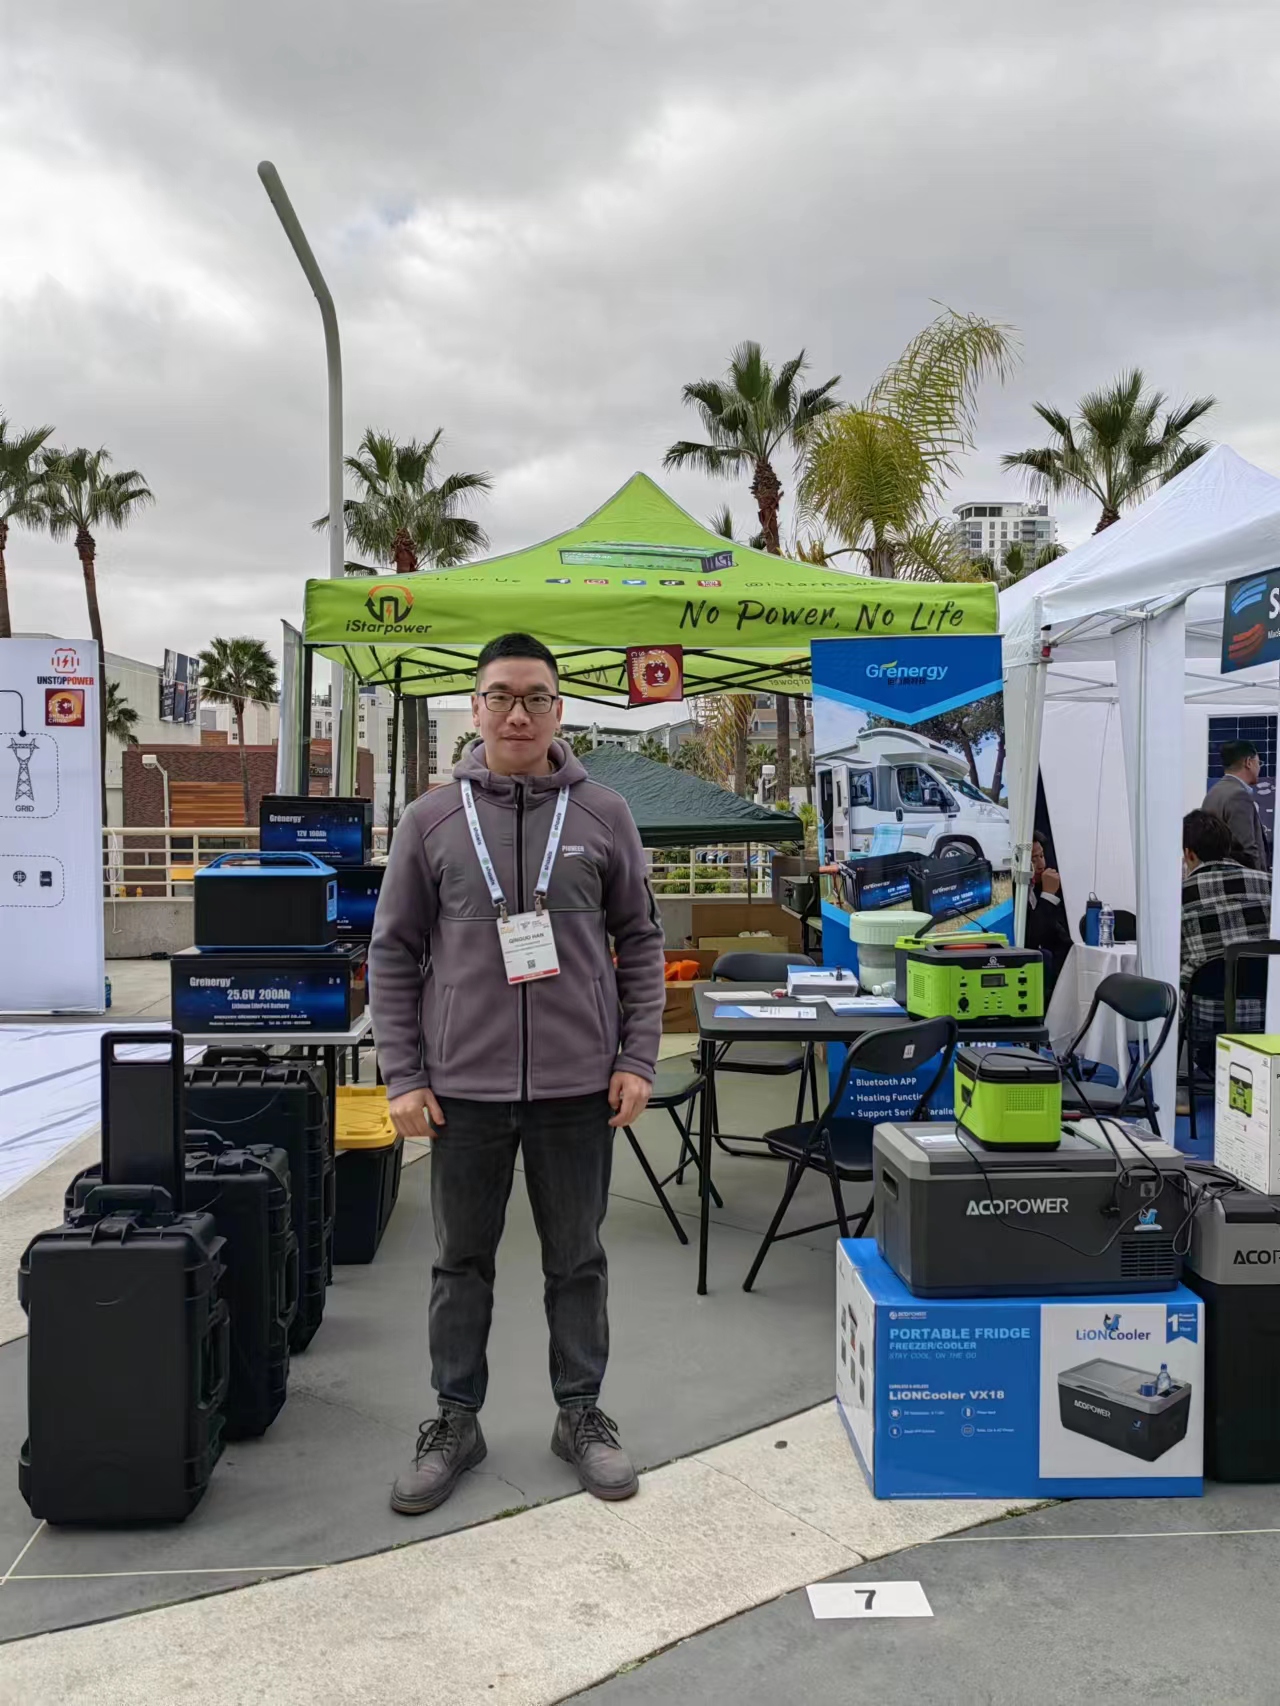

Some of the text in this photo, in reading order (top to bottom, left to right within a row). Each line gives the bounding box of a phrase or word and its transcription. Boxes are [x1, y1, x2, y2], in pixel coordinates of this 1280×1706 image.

[679, 600, 964, 632] No Power, No Life
[346, 619, 432, 635] iStarpower
[37, 676, 94, 686] UNSTOPPOWER
[15, 804, 34, 812] GRID
[227, 989, 290, 1000] 25.6V 200Ah
[856, 1078, 898, 1086] Bluetooth
[856, 1094, 890, 1103] Heating
[858, 1109, 892, 1118] Support
[928, 1108, 956, 1116] aralle
[966, 1198, 1069, 1216] ACOPOWER
[1168, 1314, 1178, 1332] 1
[890, 1328, 1030, 1339] PORTABLE FRIDGE
[1076, 1329, 1151, 1340] LiONCooler
[889, 1391, 1004, 1400] LiONCooler VX18
[1074, 1399, 1111, 1419] ACOPOWER
[854, 1589, 876, 1610] 7
